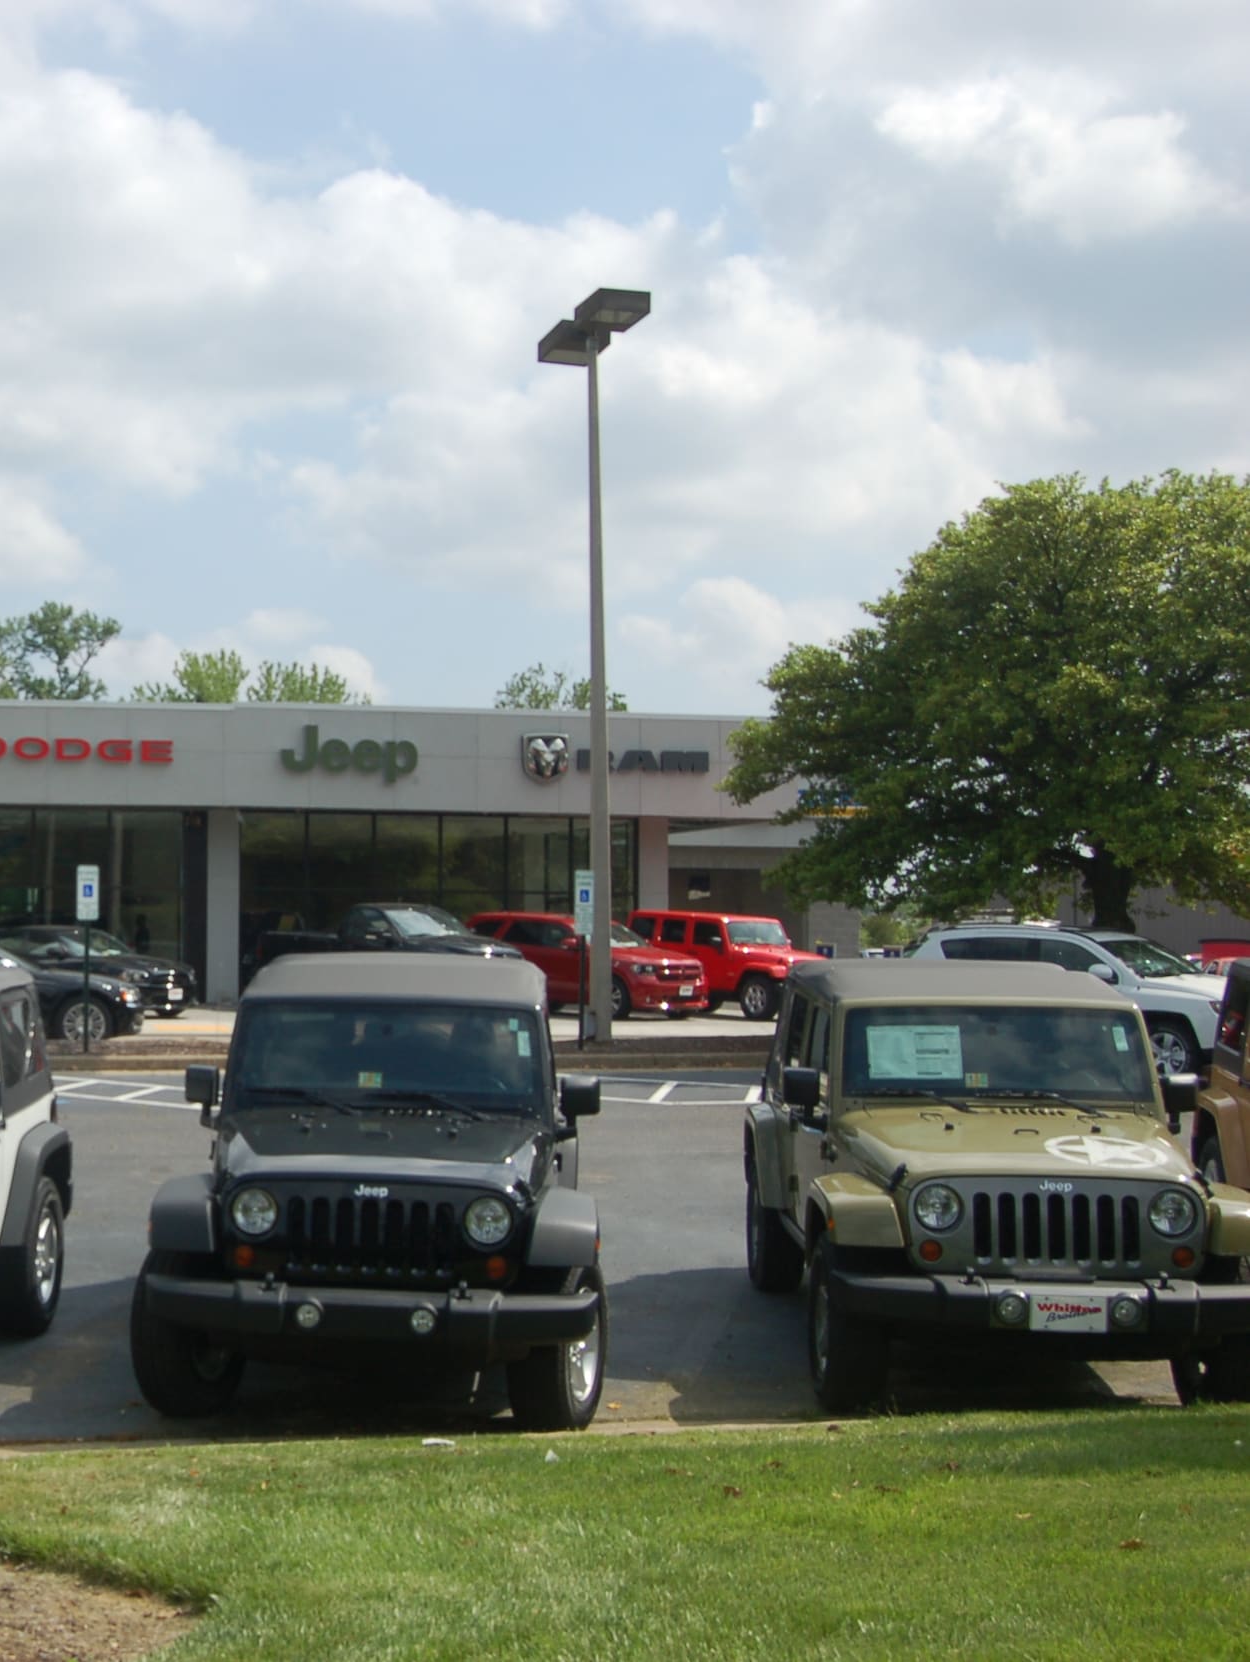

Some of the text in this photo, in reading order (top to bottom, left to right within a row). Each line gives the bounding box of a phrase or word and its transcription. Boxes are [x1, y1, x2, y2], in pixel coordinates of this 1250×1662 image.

[280, 724, 418, 784] Jeep
[354, 1184, 388, 1198] Jeep
[1039, 1179, 1072, 1192] Jeep
